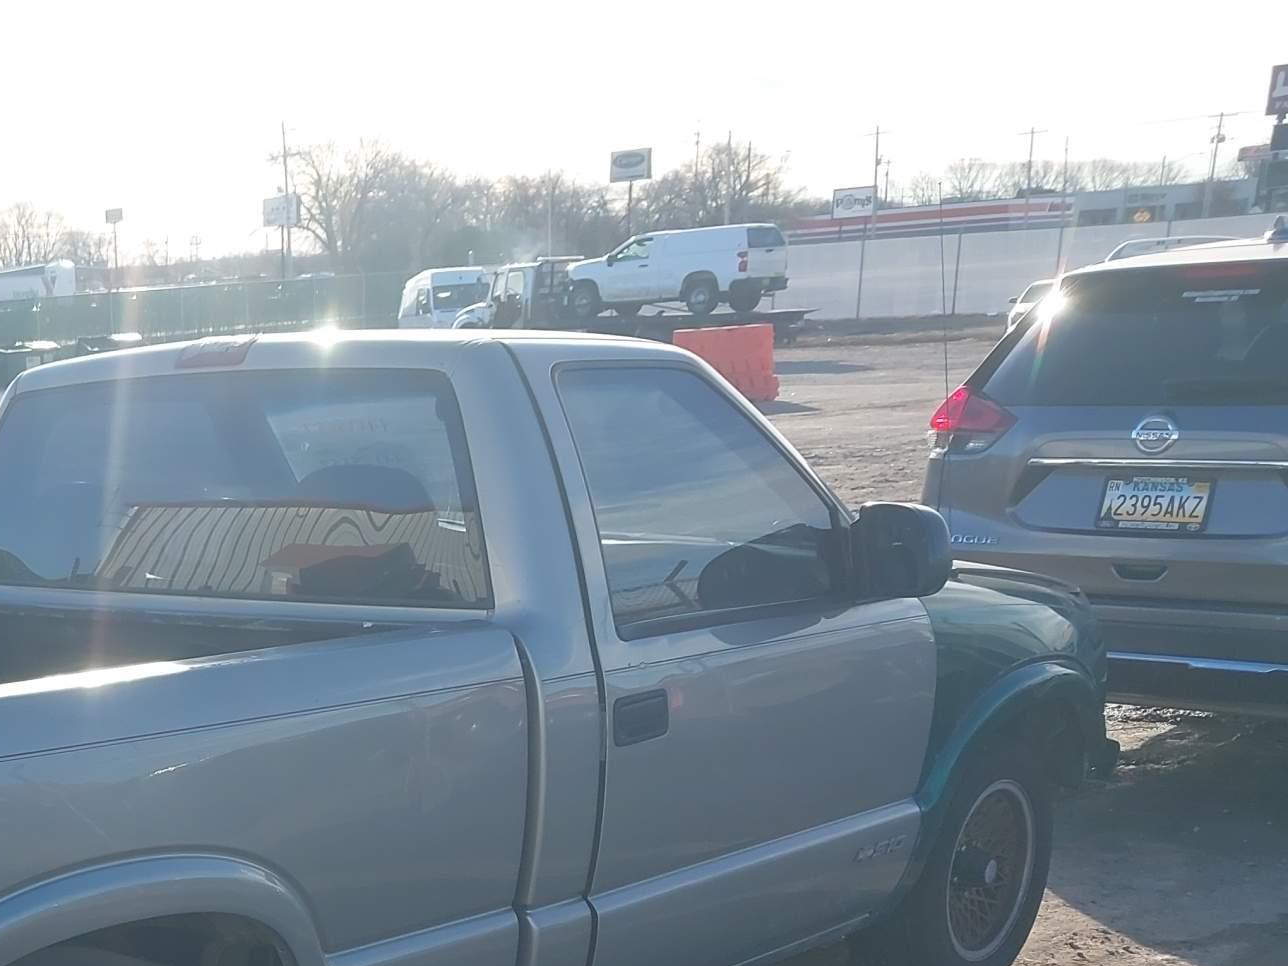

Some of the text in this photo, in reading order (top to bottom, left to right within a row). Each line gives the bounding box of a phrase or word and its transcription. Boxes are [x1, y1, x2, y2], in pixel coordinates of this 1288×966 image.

[1132, 481, 1184, 493] KANSAS
[1113, 494, 1204, 518] 2395AKZ
[950, 535, 1000, 545] OGUE
